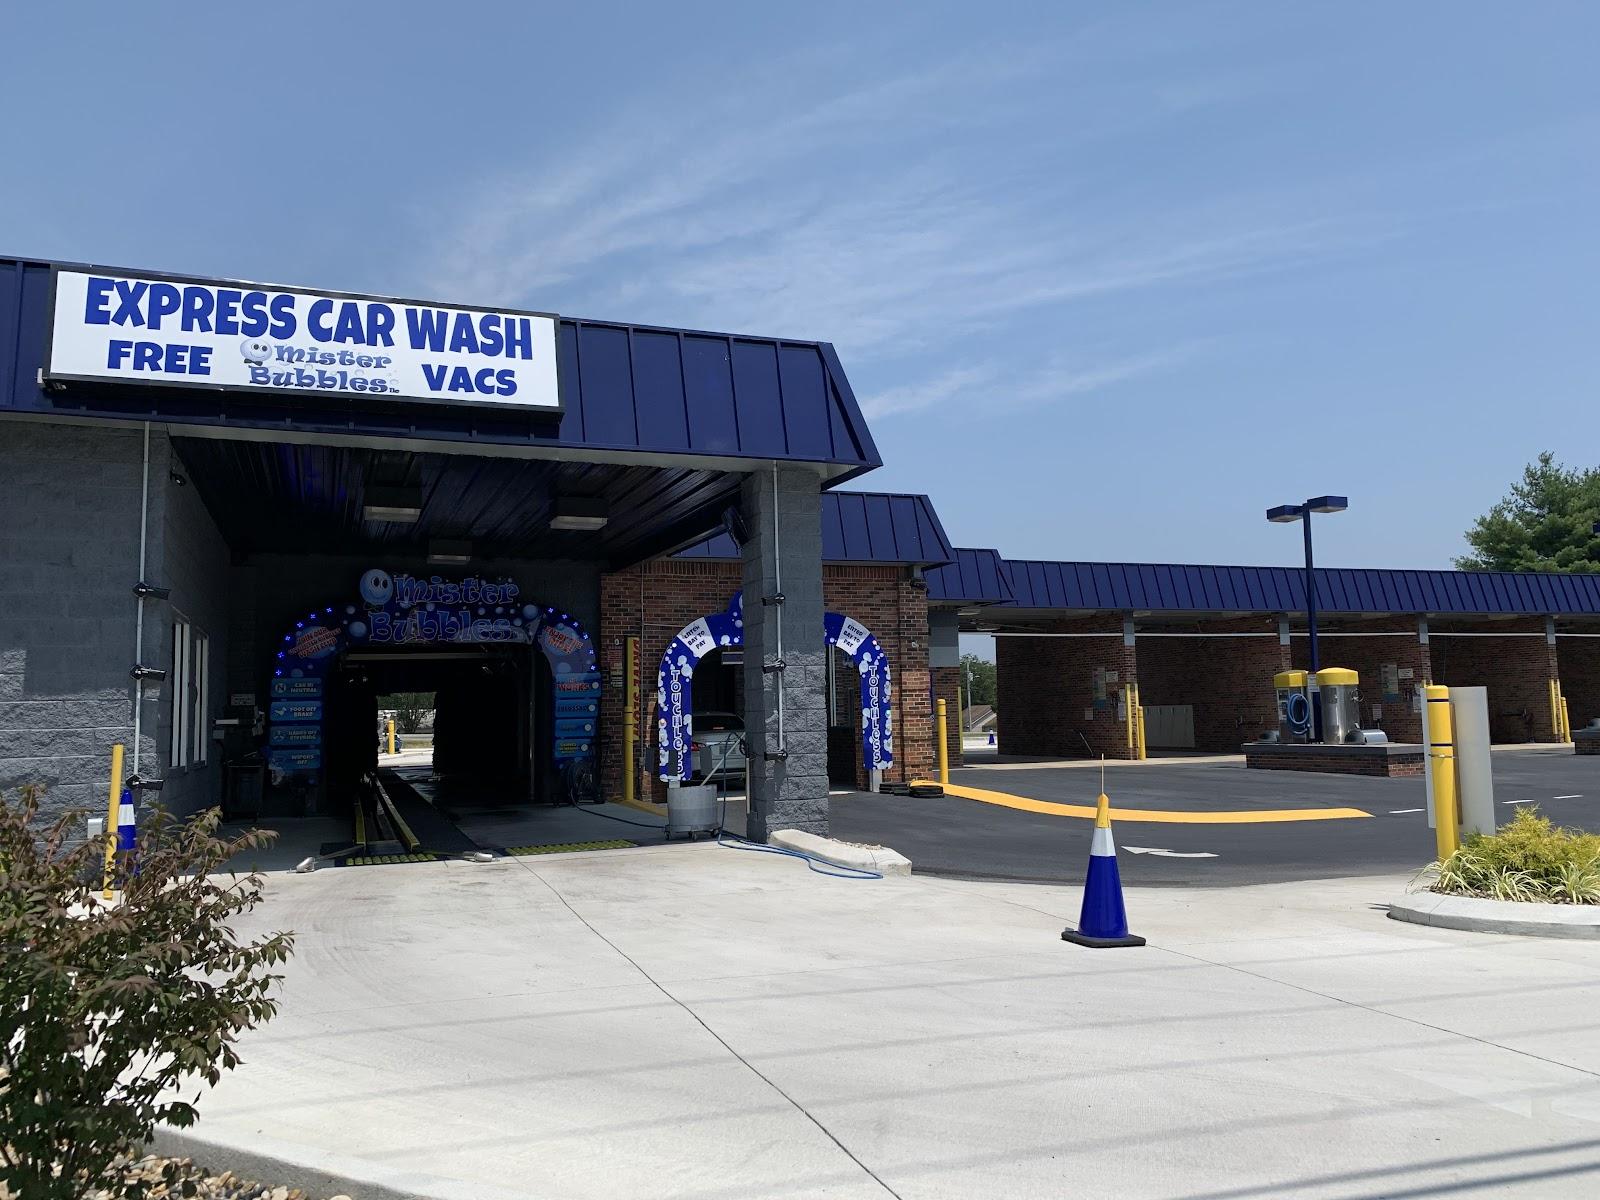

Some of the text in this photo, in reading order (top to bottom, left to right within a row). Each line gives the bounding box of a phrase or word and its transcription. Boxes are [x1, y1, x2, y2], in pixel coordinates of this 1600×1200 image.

[85, 277, 533, 361] EXPRESS CAR WASH
[107, 339, 214, 376] FREE
[274, 344, 392, 369] Mister
[248, 365, 388, 394] Bubbles
[421, 363, 518, 397] VACS
[393, 575, 520, 605] Mister
[367, 609, 513, 644] Bubbles
[695, 640, 706, 650] PAY
[843, 639, 854, 648] PAY
